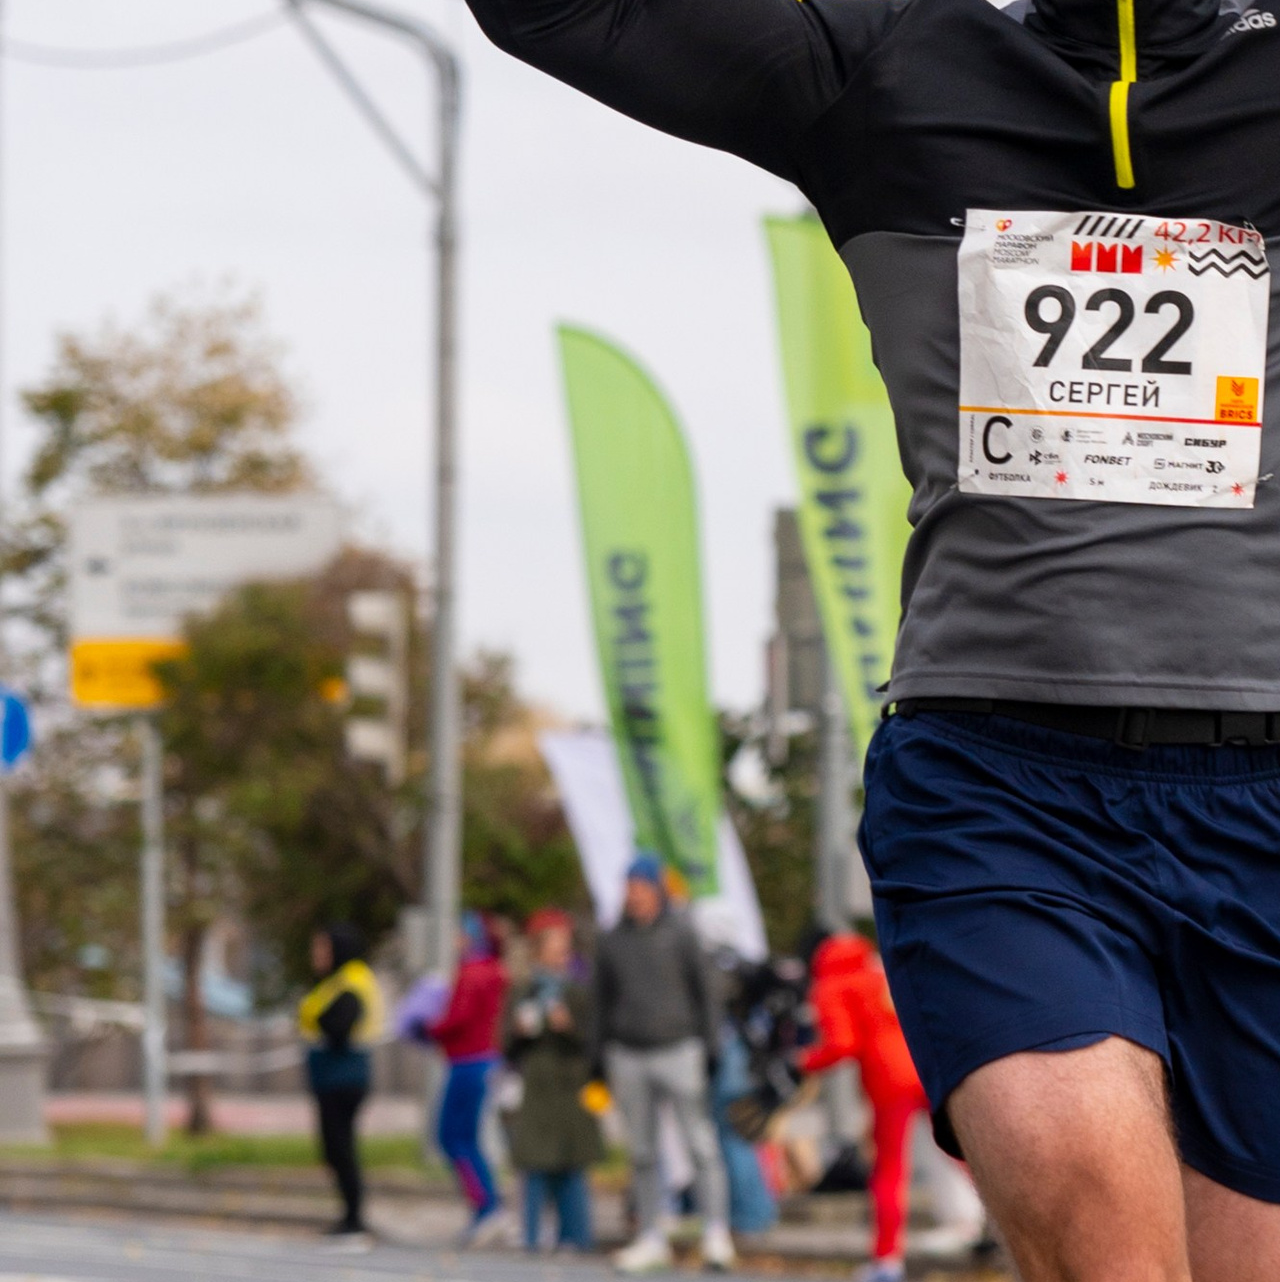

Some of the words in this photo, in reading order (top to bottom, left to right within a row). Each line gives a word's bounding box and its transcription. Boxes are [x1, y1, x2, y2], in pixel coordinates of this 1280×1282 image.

[1154, 220, 1212, 246] 42,2
[1024, 284, 1194, 375] 922
[1049, 381, 1160, 407] СЕРГЕЙ
[1220, 409, 1253, 420] BRICS
[1184, 438, 1227, 448] СИБУР
[1084, 454, 1132, 466] FONBET
[1149, 481, 1203, 492] ДОЖДЕВИК
